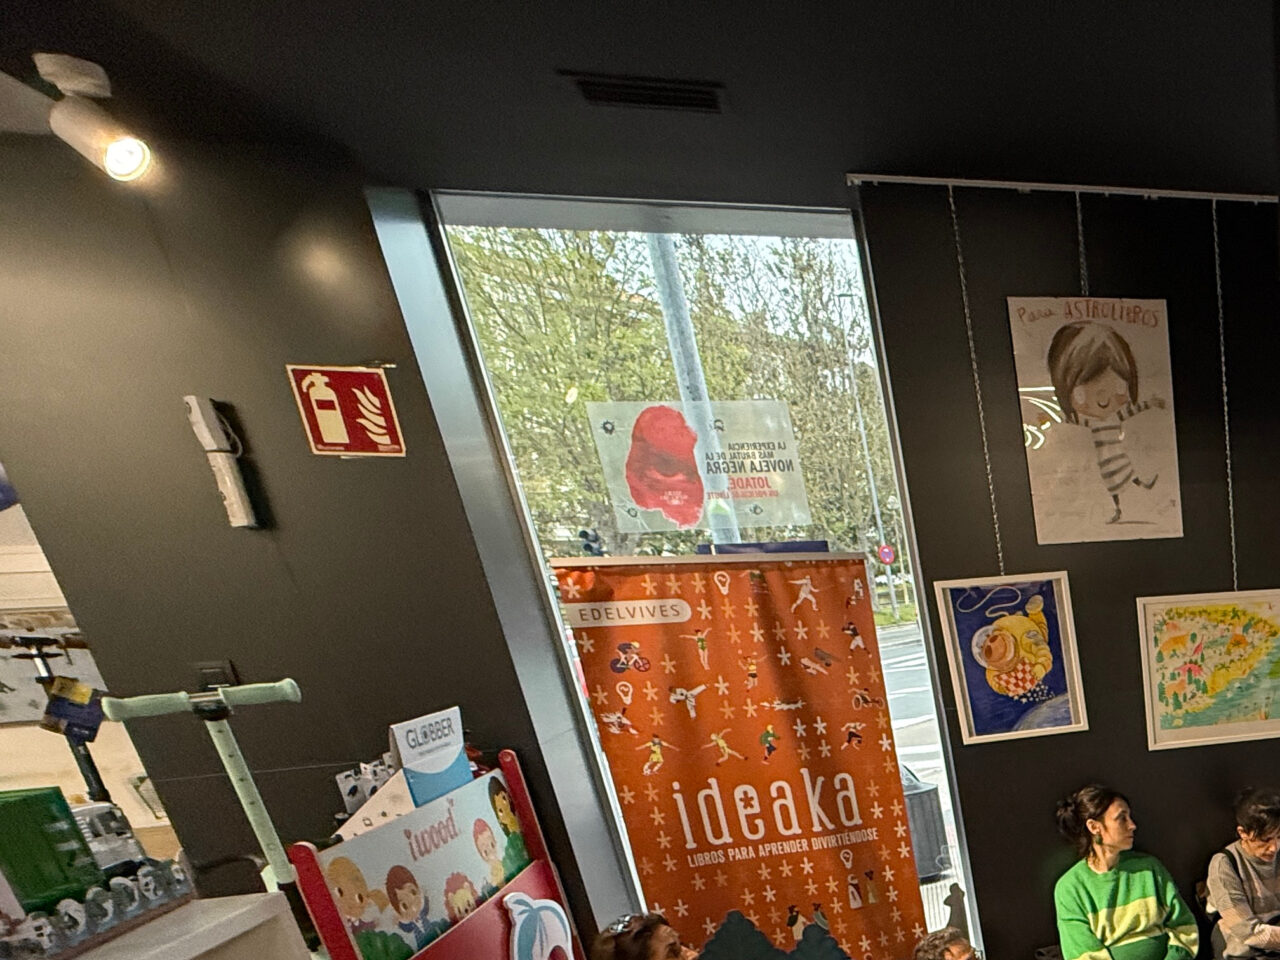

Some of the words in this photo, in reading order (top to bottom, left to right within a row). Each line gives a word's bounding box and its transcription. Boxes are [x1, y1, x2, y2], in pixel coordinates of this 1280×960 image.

[578, 603, 681, 622] EDELVIVES
[671, 767, 863, 849] ideaka
[687, 850, 726, 868] LIBROS
[727, 845, 757, 862] PARA
[758, 839, 809, 858] APRENDER
